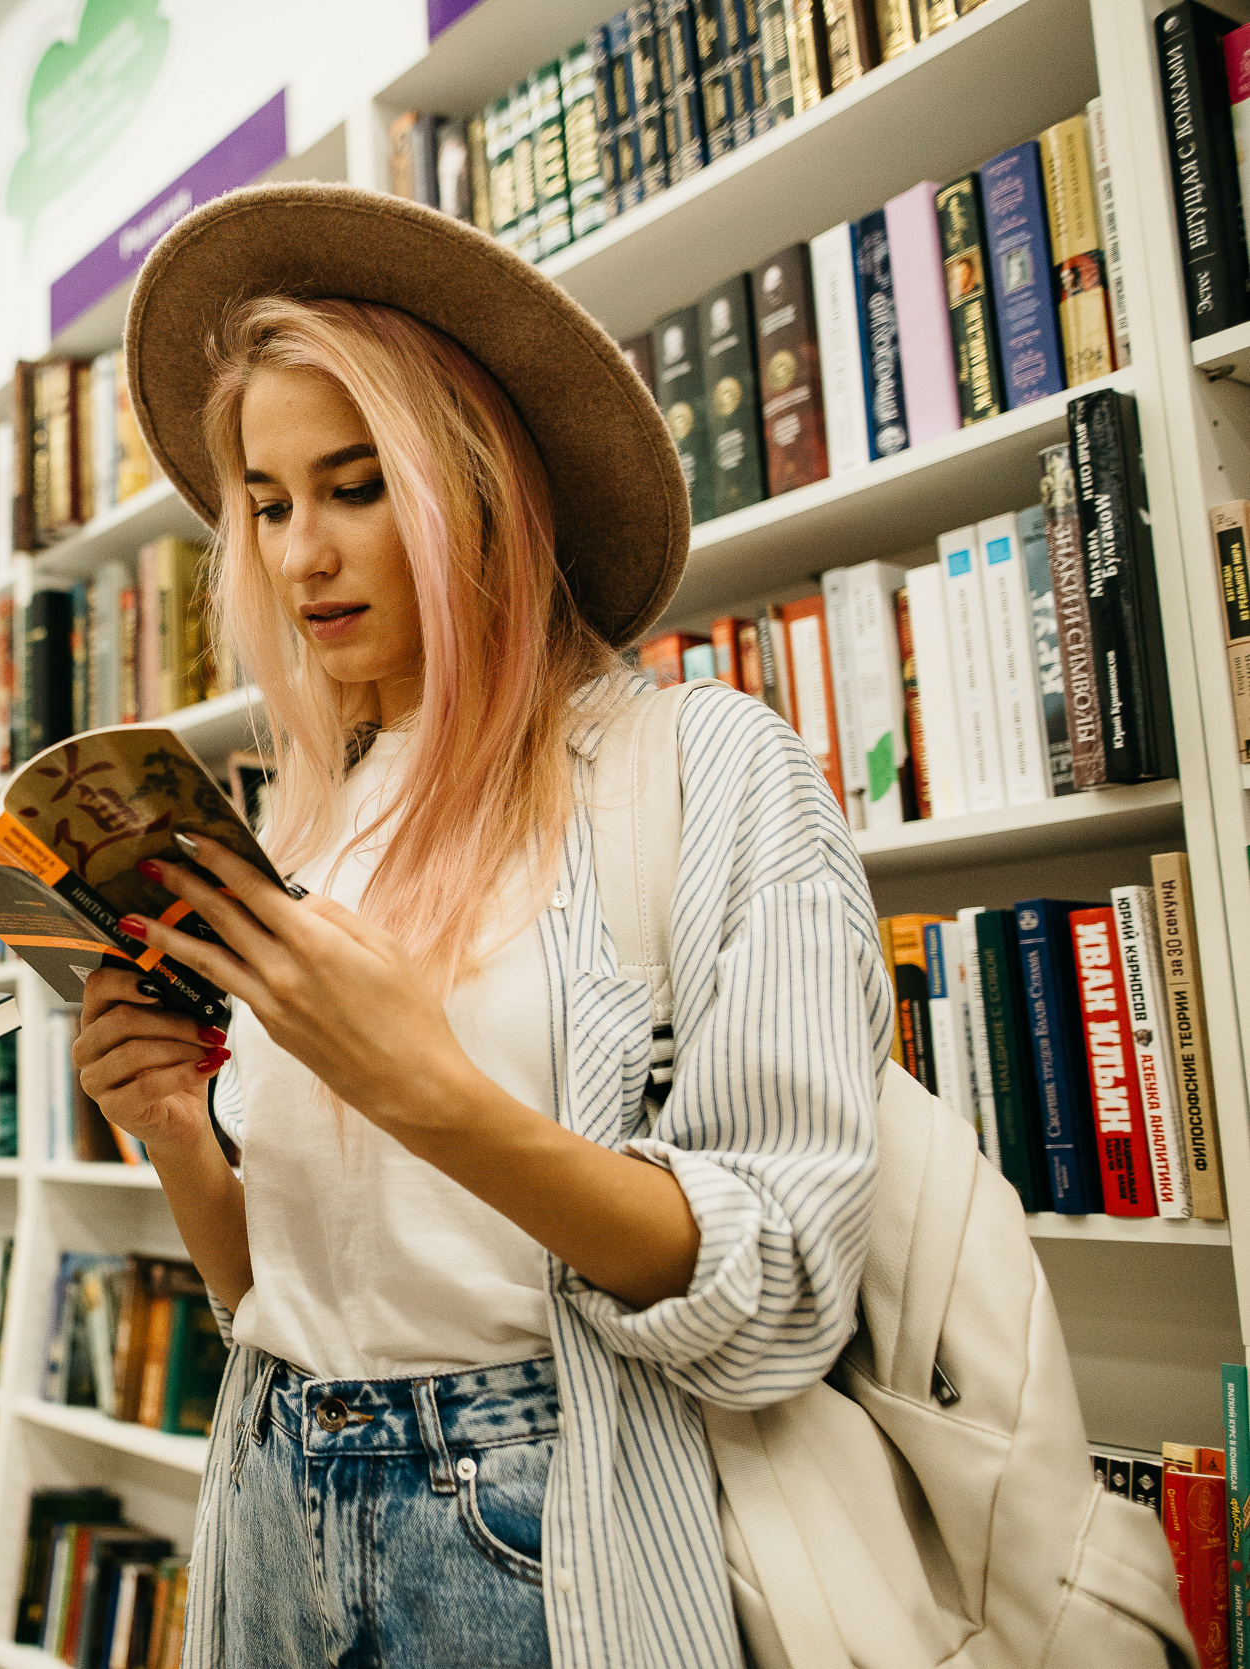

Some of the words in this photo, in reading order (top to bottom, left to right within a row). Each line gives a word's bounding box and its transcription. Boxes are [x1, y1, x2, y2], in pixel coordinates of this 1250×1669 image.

[1166, 44, 1194, 140] ВОЛКАМИ
[1178, 142, 1196, 159] С
[1180, 161, 1207, 250] БЕГУЩАЯ
[1196, 270, 1214, 315] Эстес
[1087, 529, 1104, 598] Михаил
[1231, 542, 1242, 566] МИРА
[1223, 564, 1236, 602] ВЗГЛЯДЫ
[1234, 566, 1248, 610] РЕАЛЬНОГО
[1054, 525, 1080, 603] ЗНАКИ
[1067, 628, 1096, 742] СИМВОЛЫ
[1240, 610, 1250, 621] ИЗ
[1032, 590, 1064, 694] КРУГ
[1106, 650, 1123, 714] Кривоносов
[1112, 715, 1126, 749] Юрий
[1117, 897, 1140, 940] ЮРИЙ
[1162, 879, 1179, 936] секунд
[1075, 922, 1117, 1013] ИВАН
[1166, 938, 1183, 956] 30
[1172, 960, 1183, 976] за
[1124, 945, 1148, 1021] КУРНОСОВ
[1174, 990, 1193, 1049] ТЕОРИИ
[1088, 1020, 1132, 1133] ИЛЬИН
[1141, 1054, 1161, 1109] АЗБУКА
[1182, 1053, 1207, 1171] ФИЛОСОФСКИЕ
[1150, 1115, 1174, 1202] АНАЛИТИКИ
[1227, 1382, 1237, 1417] КРАТКИЙ
[1228, 1419, 1236, 1439] КУРС
[1229, 1446, 1238, 1491] КОМИКСАХ
[1230, 1498, 1242, 1553] ФИЛОСОФИЯ
[1234, 1584, 1244, 1618] МАЙКЛ
[1235, 1620, 1244, 1655] ПАТТОН
